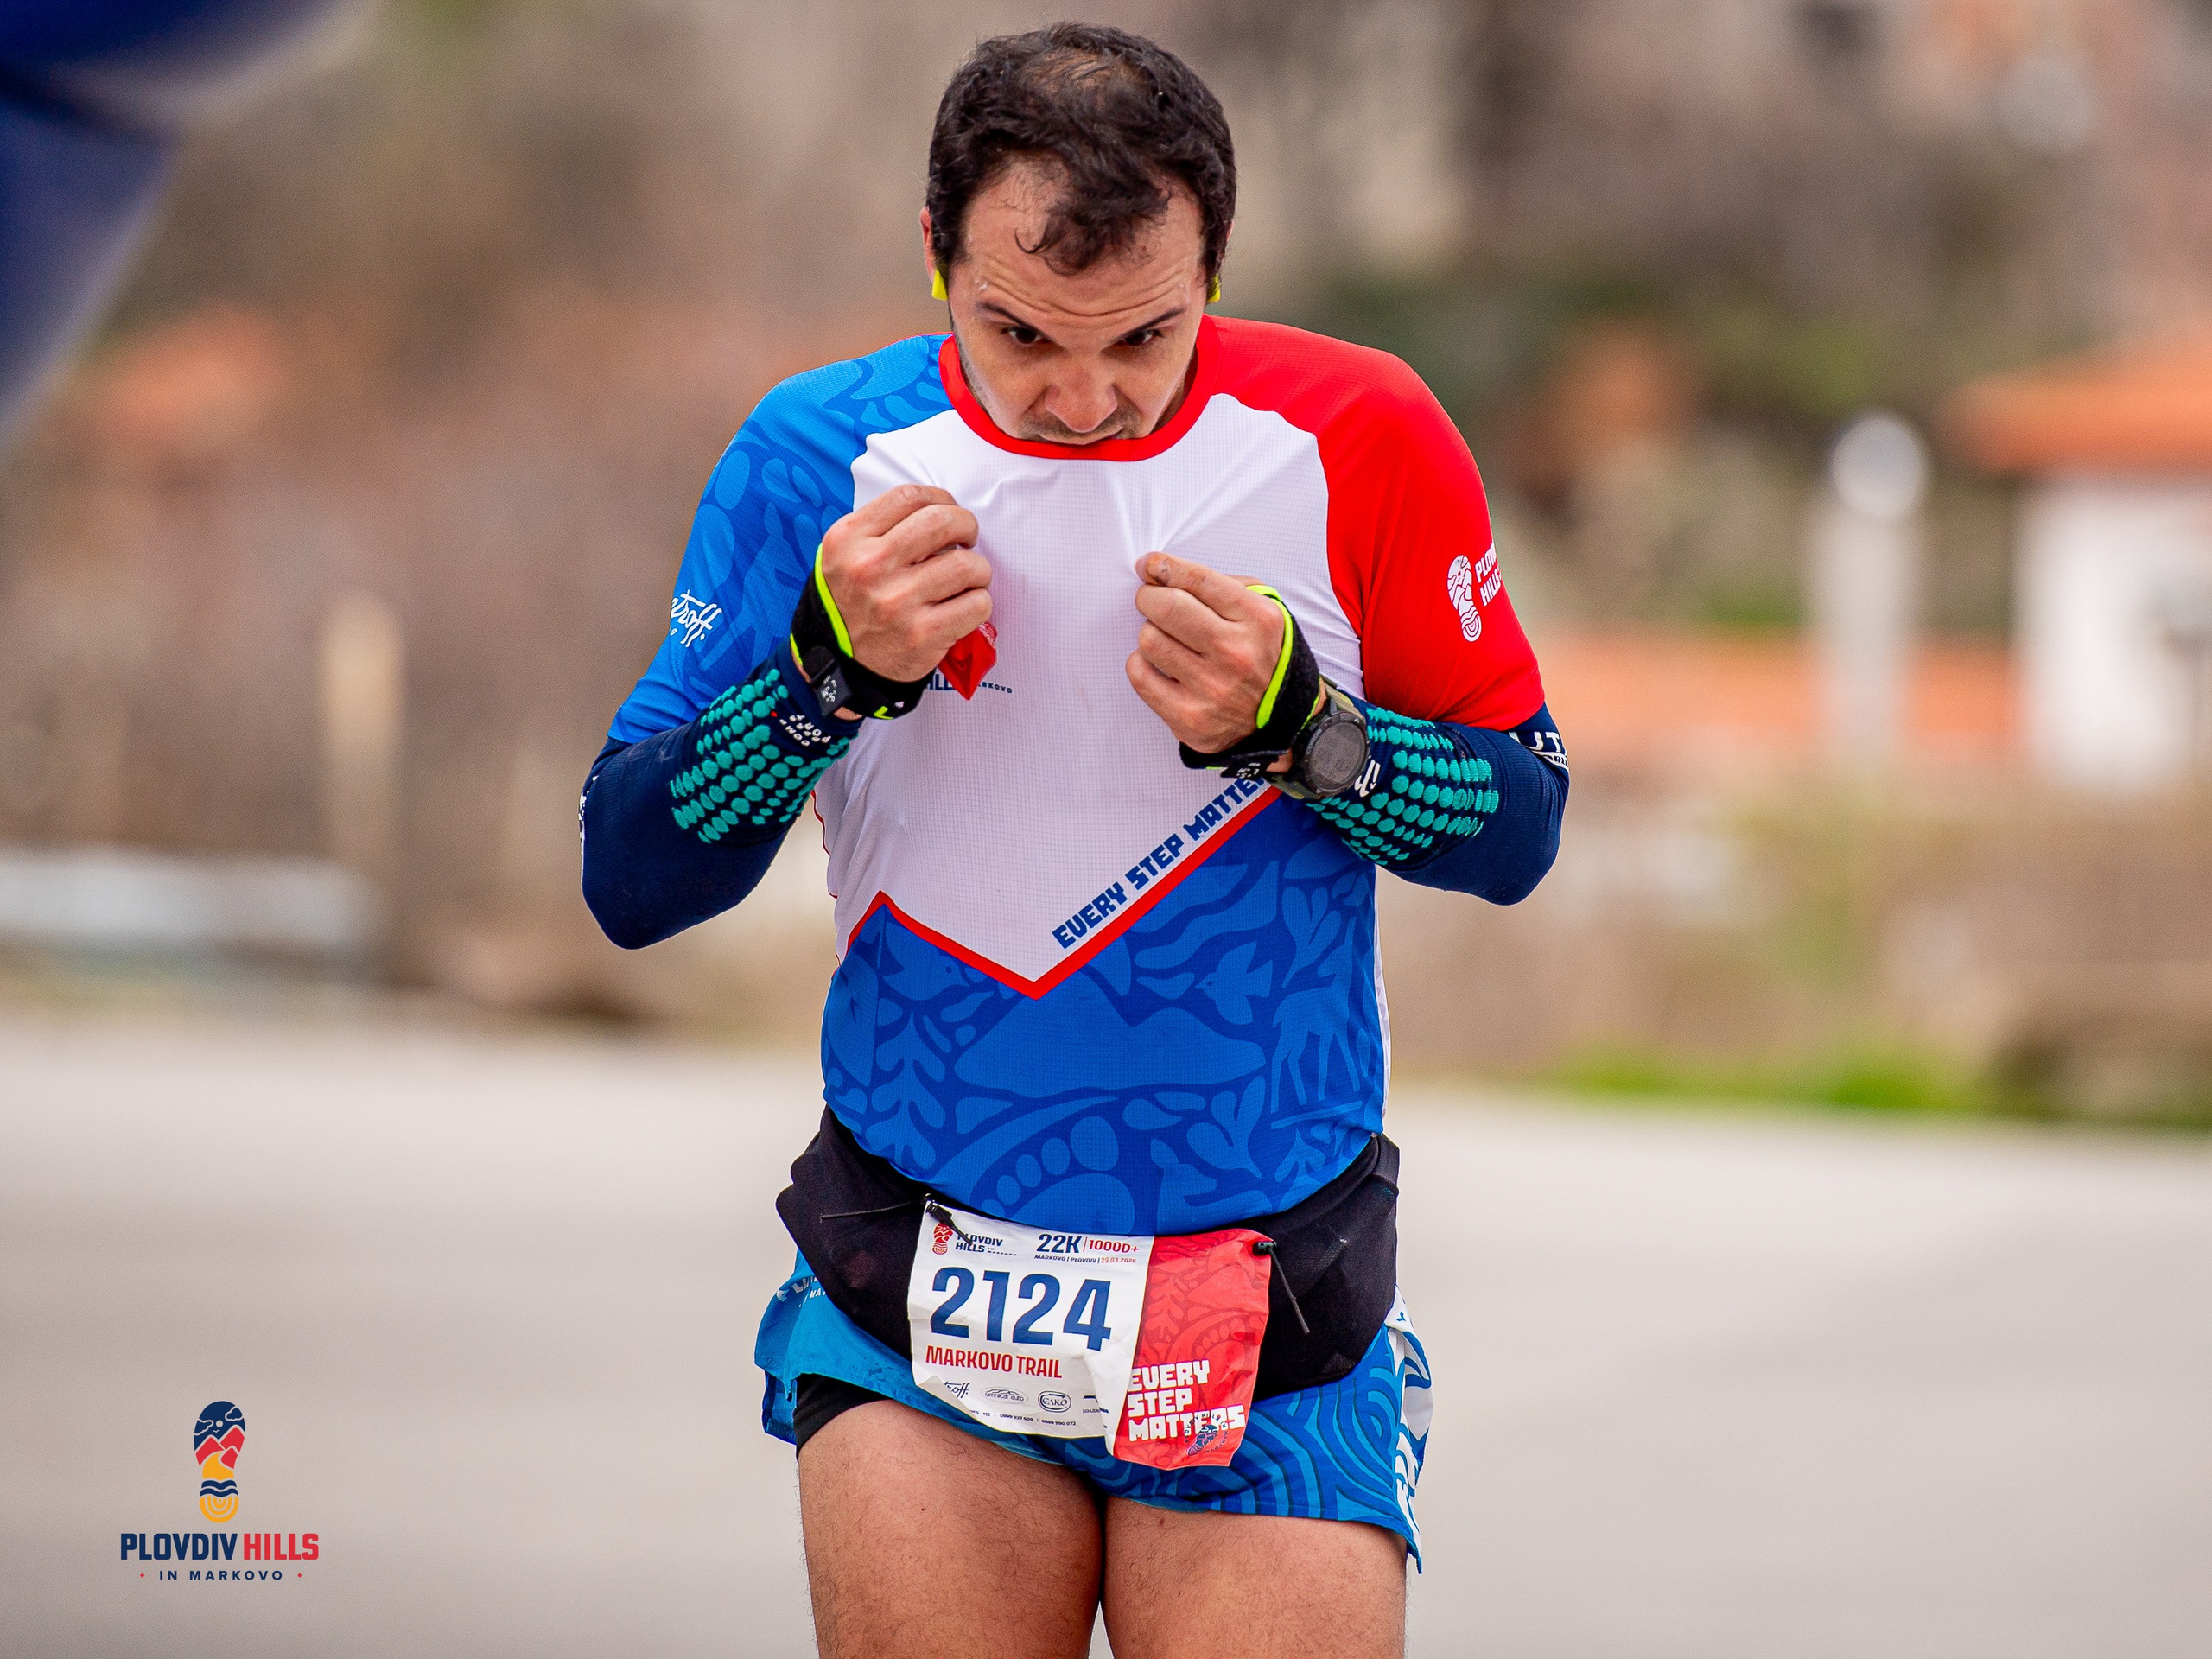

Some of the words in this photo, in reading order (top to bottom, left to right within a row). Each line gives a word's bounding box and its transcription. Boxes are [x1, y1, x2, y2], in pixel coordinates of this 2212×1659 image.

[1052, 881, 1128, 949] EVERY
[1125, 833, 1185, 891] STEP
[955, 1242, 985, 1253] HILLS
[1037, 1234, 1083, 1253] 22K
[1089, 1239, 1139, 1253] 1000D+
[930, 1267, 1112, 1351] 2124
[925, 1345, 1013, 1373] MARKOVO
[1016, 1356, 1063, 1378] TRAIL
[1127, 1359, 1210, 1392] EVERY
[1128, 1388, 1192, 1417] STEP
[1128, 1404, 1246, 1441] MATTERS
